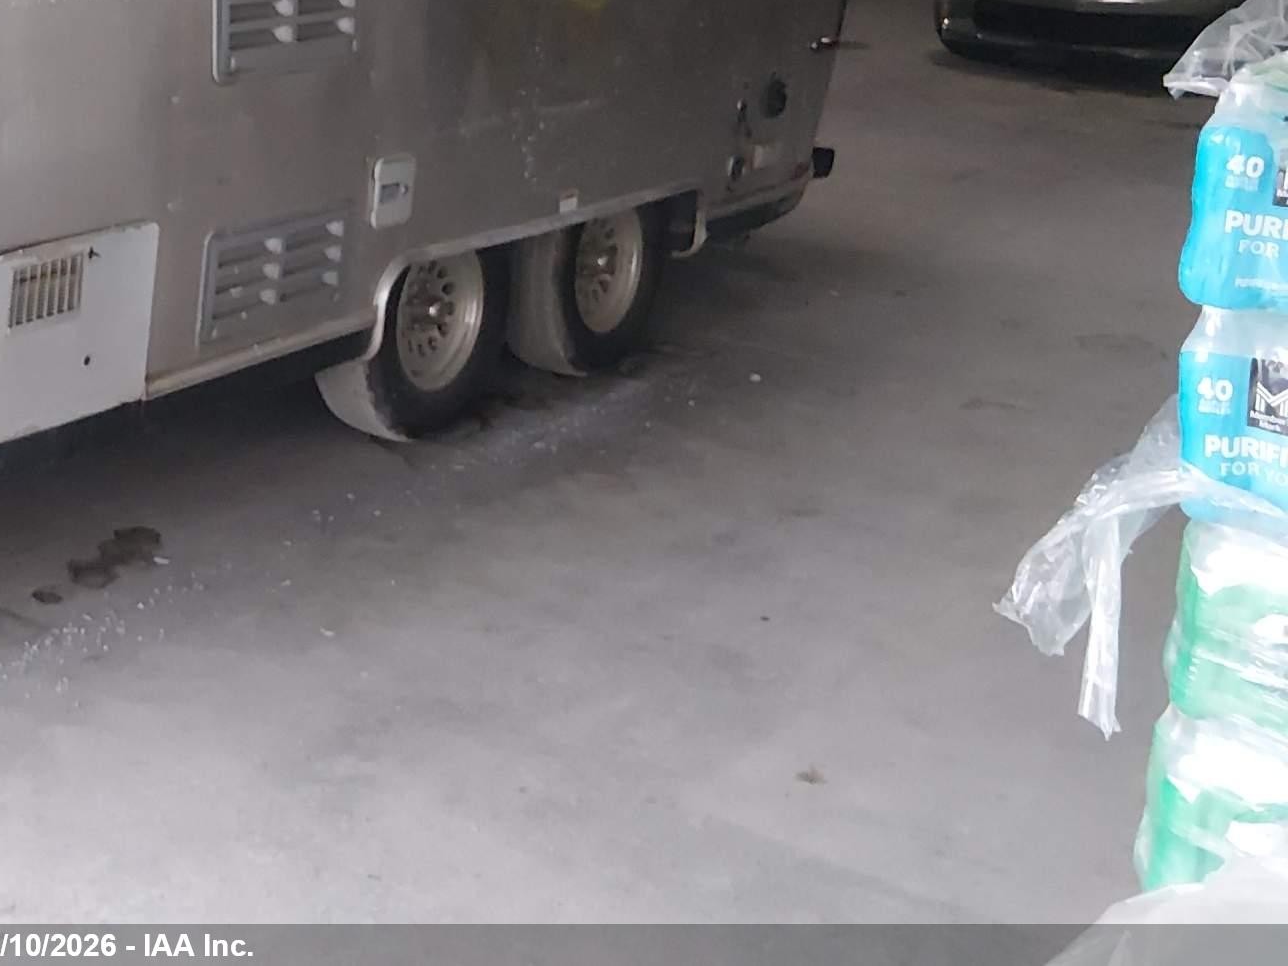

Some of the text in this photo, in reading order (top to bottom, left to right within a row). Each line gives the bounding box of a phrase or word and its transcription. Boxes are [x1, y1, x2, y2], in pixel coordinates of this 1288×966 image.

[1226, 154, 1265, 178] 40
[1238, 239, 1280, 258] FOR
[1197, 376, 1233, 402] 40
[1220, 460, 1260, 477] FOR
